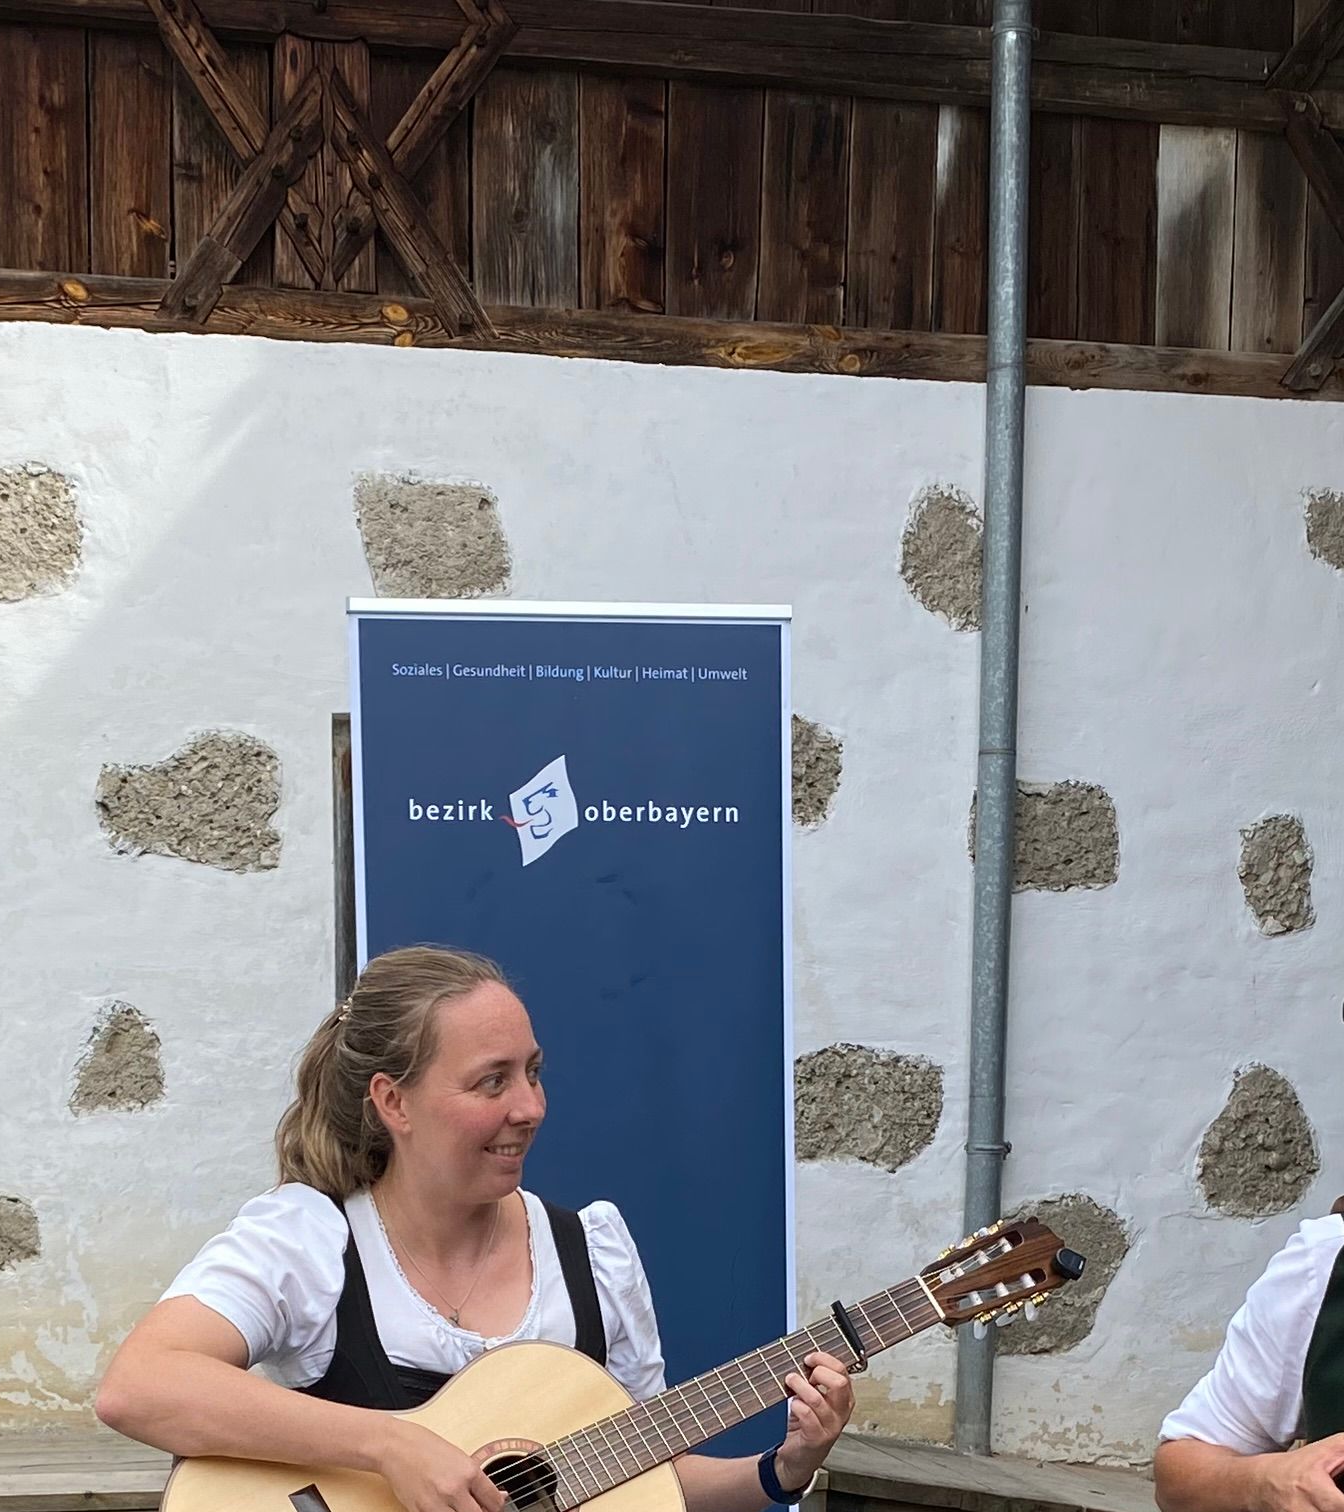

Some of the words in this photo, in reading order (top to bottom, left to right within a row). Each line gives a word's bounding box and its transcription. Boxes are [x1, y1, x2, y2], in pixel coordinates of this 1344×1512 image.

[392, 663, 443, 677] Soziales
[452, 663, 526, 678] Gesundheit
[535, 664, 585, 682] Bildung
[594, 665, 633, 679] Kultur
[642, 667, 688, 680] Heimat
[698, 667, 748, 681] Umwelt
[409, 799, 494, 821] bezirk
[584, 800, 739, 829] oberbayern
